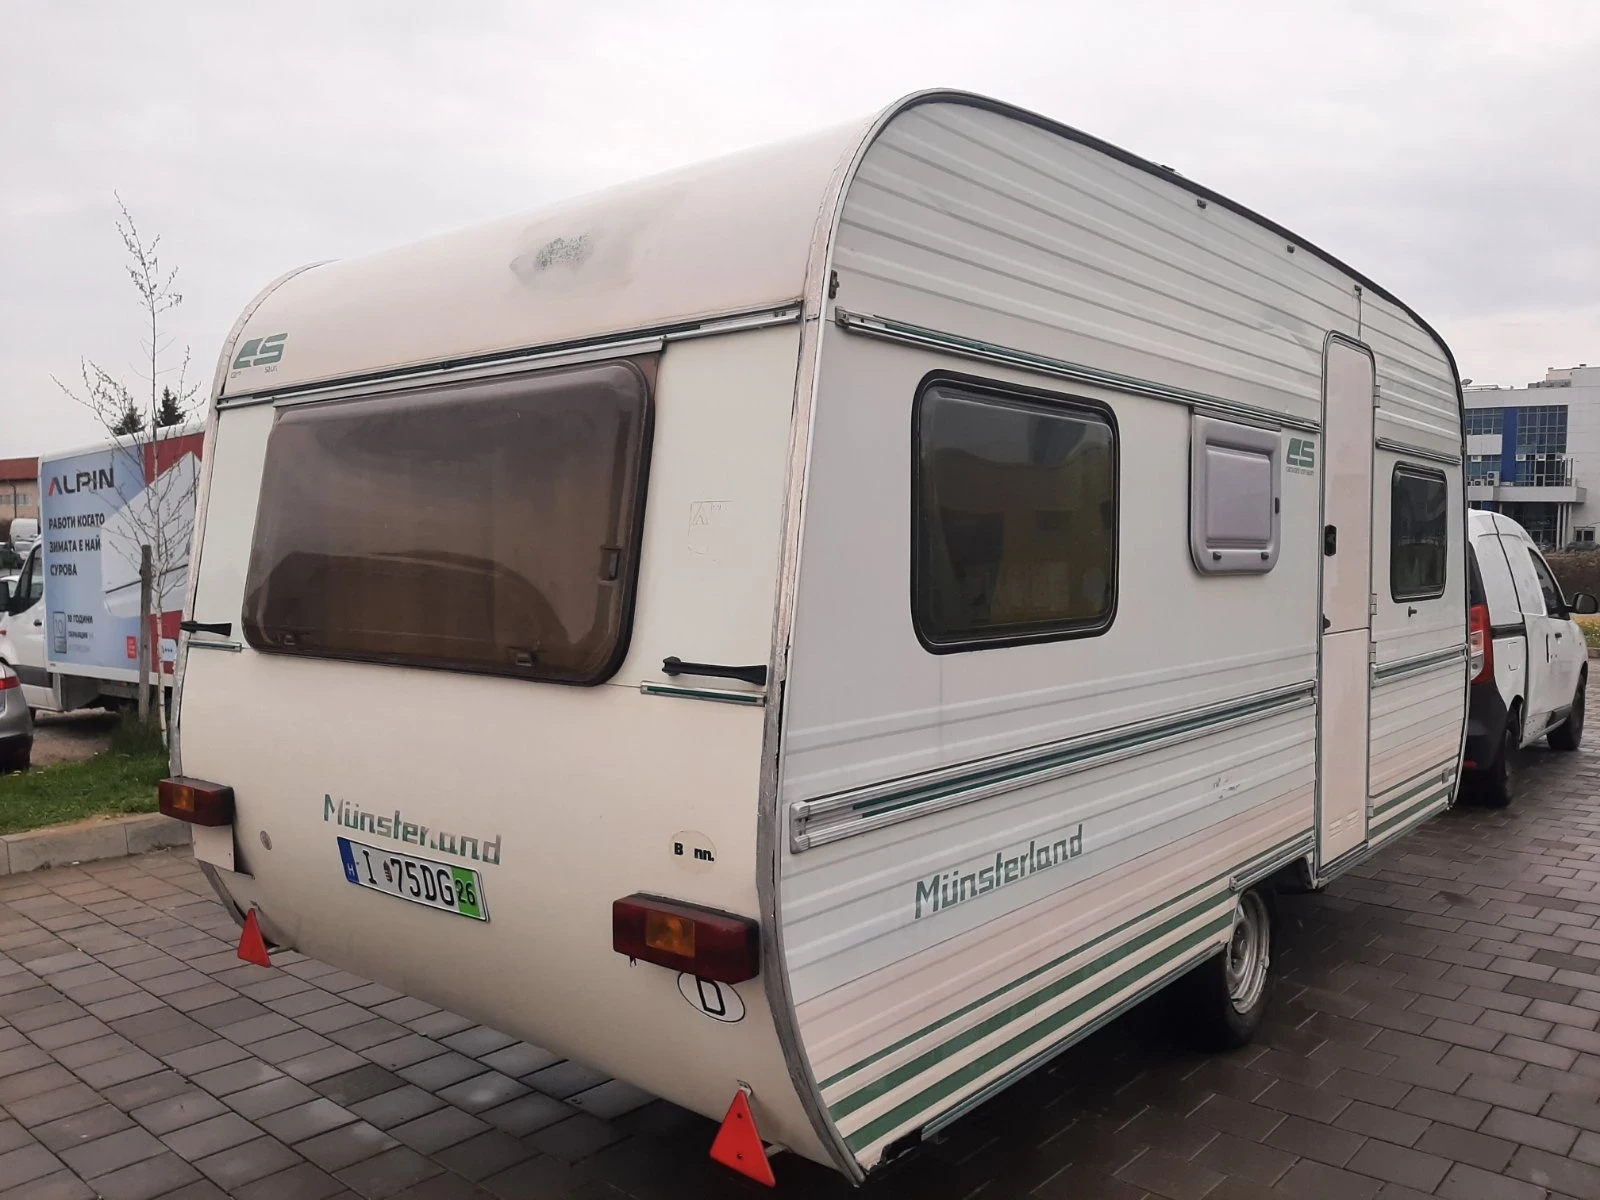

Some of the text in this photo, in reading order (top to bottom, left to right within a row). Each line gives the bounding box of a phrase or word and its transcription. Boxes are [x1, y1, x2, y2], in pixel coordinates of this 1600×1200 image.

[48, 467, 114, 496] ALPIN
[48, 513, 105, 530] РАБОТИ КОГАТО
[49, 539, 77, 553] ЗИМАТА
[85, 534, 101, 551] НАЙ
[50, 563, 77, 576] СУРОВА
[915, 824, 1082, 919] Münsterland
[454, 878, 476, 906] 26
[695, 974, 726, 1016] D
